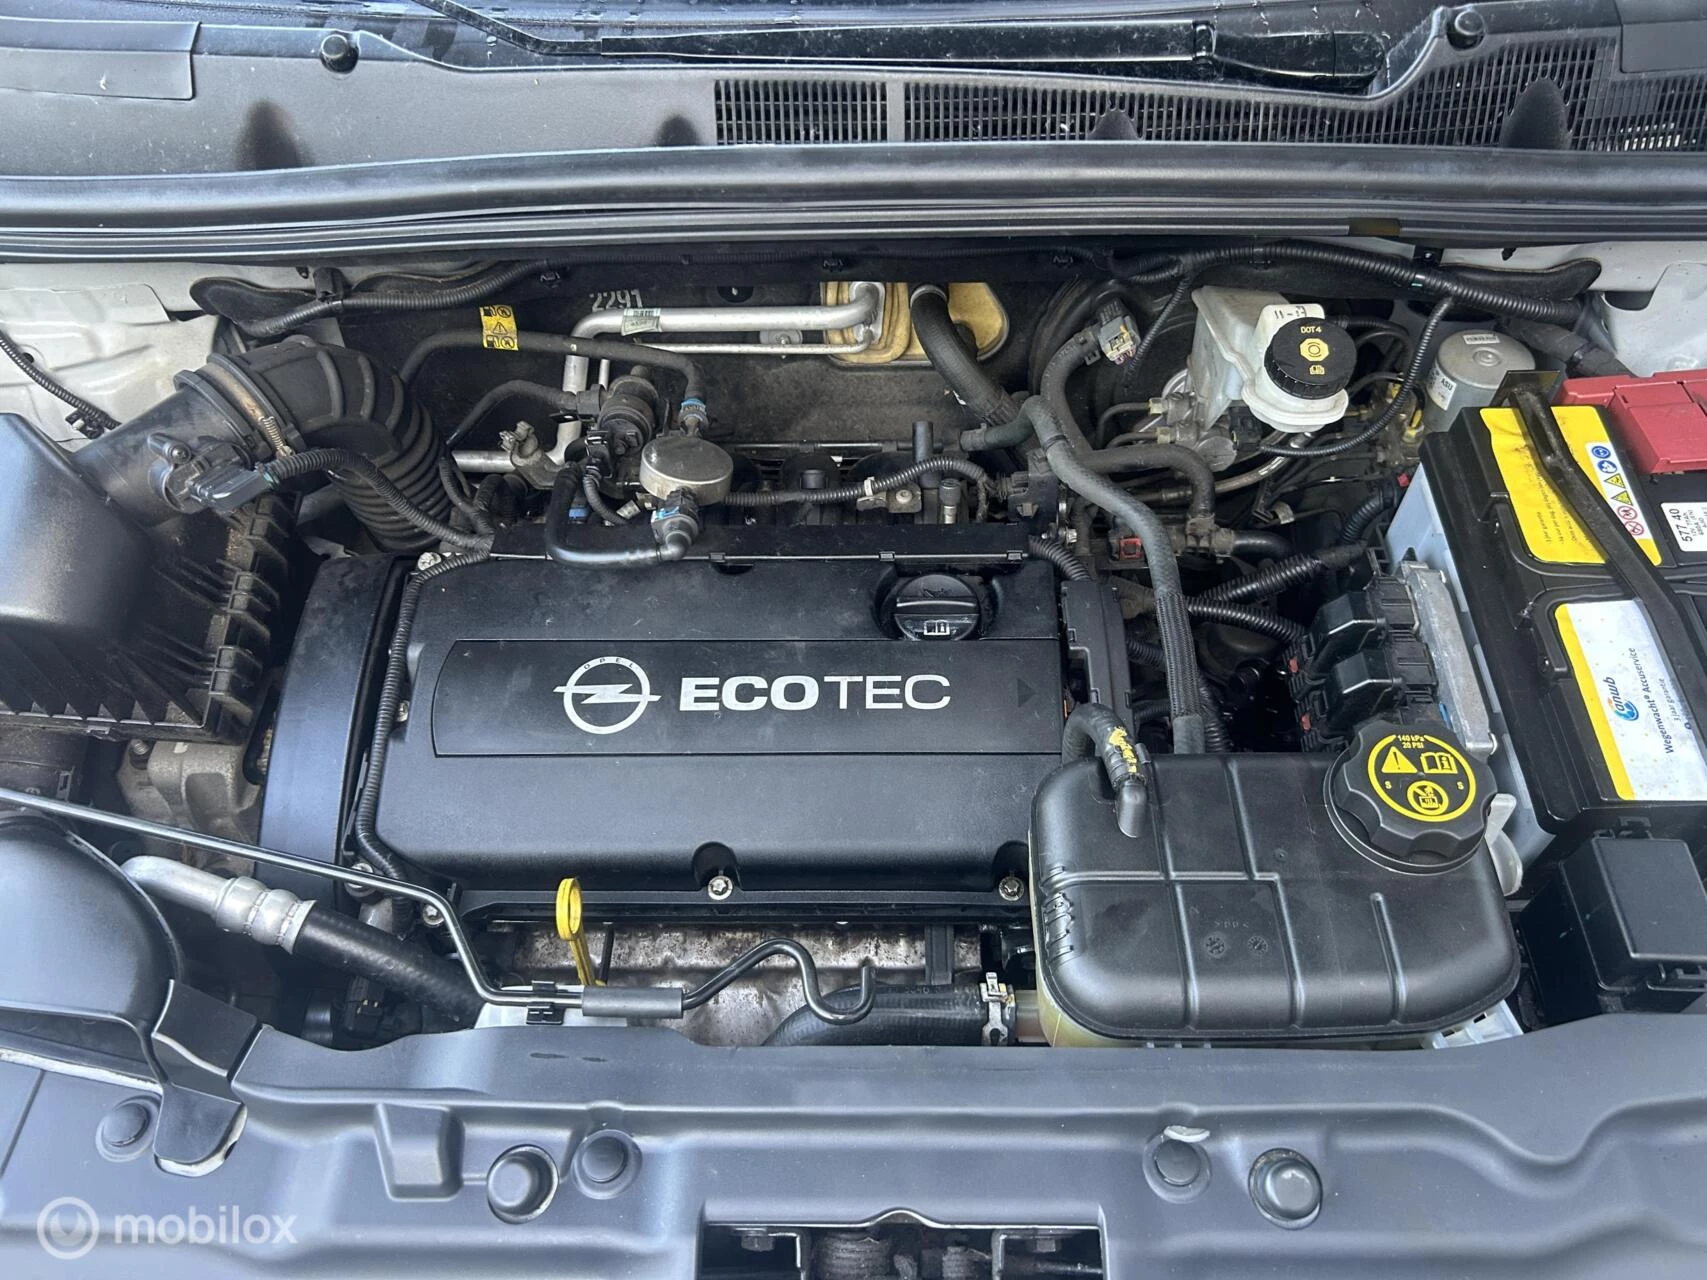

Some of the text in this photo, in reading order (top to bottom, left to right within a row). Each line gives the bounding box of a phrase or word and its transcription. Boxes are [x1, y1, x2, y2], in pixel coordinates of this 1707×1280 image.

[1300, 326, 1315, 334] DOT
[1669, 508, 1693, 542] 577 40
[583, 657, 634, 670] OPEL
[1629, 647, 1652, 693] Accuservice
[679, 674, 951, 711] ECOTEC
[1603, 676, 1625, 711] anwb
[1658, 678, 1676, 704] garantie
[1411, 741, 1425, 749] PSI
